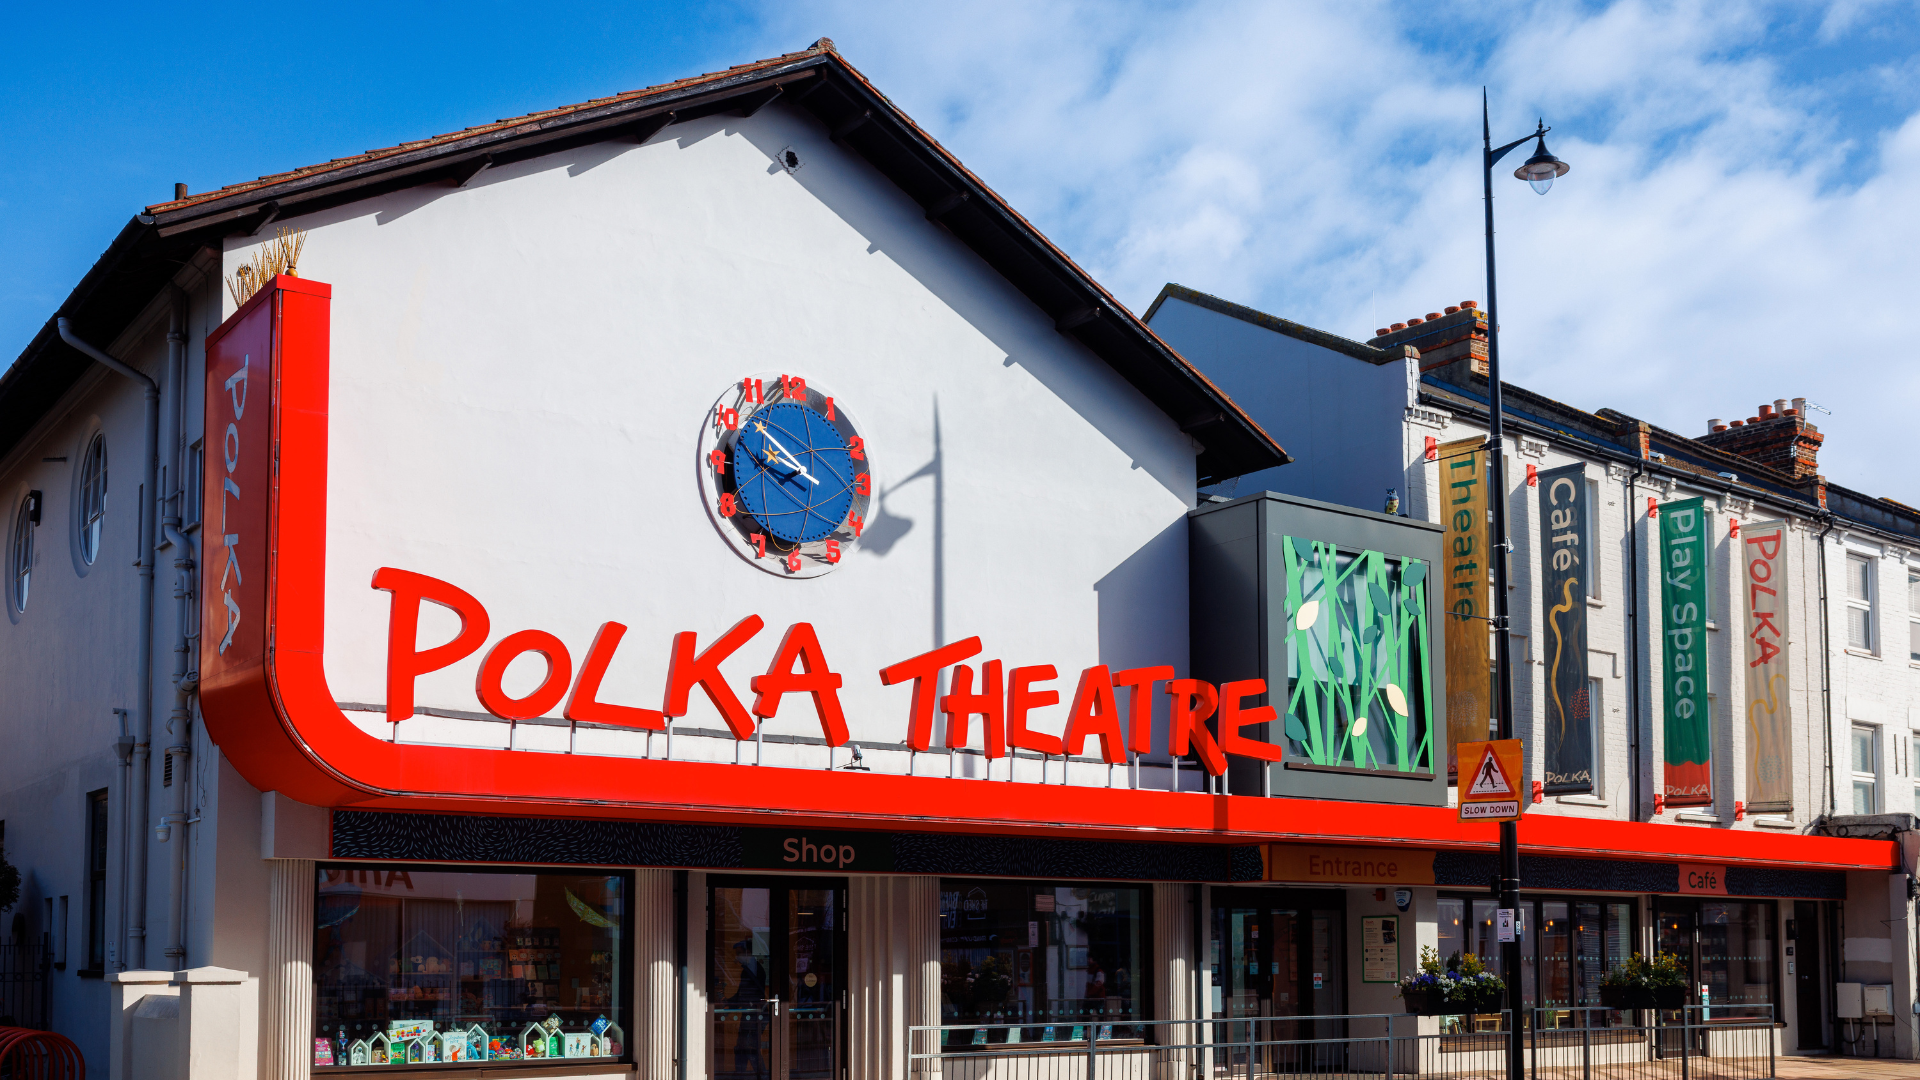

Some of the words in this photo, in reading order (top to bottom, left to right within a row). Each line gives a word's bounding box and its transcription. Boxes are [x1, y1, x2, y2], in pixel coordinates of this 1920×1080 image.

[743, 377, 765, 404] 11
[781, 374, 807, 401] 12
[716, 403, 740, 431] 10
[825, 396, 836, 421] 1
[849, 435, 865, 461] 2
[710, 450, 727, 475] 9
[855, 472, 871, 496] 3
[219, 354, 249, 657] POLKA
[720, 492, 737, 517] 8
[848, 510, 864, 537] 4
[1450, 449, 1478, 622] Theatre
[1549, 477, 1580, 571] Café
[750, 533, 766, 558] 7
[825, 539, 841, 563] 5
[1666, 508, 1697, 591] Play
[787, 548, 802, 572] 6
[1746, 529, 1781, 668] POLKA
[371, 566, 850, 747] POLKA
[879, 636, 1282, 777] THEATRE
[1667, 602, 1698, 719] Space
[1545, 770, 1591, 784] POLKA
[1665, 784, 1709, 796] POLKA
[1464, 805, 1488, 815] SLOW
[1489, 804, 1515, 814] DOWN
[783, 837, 855, 869] Shop
[1309, 854, 1398, 877] Entrance
[1688, 871, 1717, 889] Café
